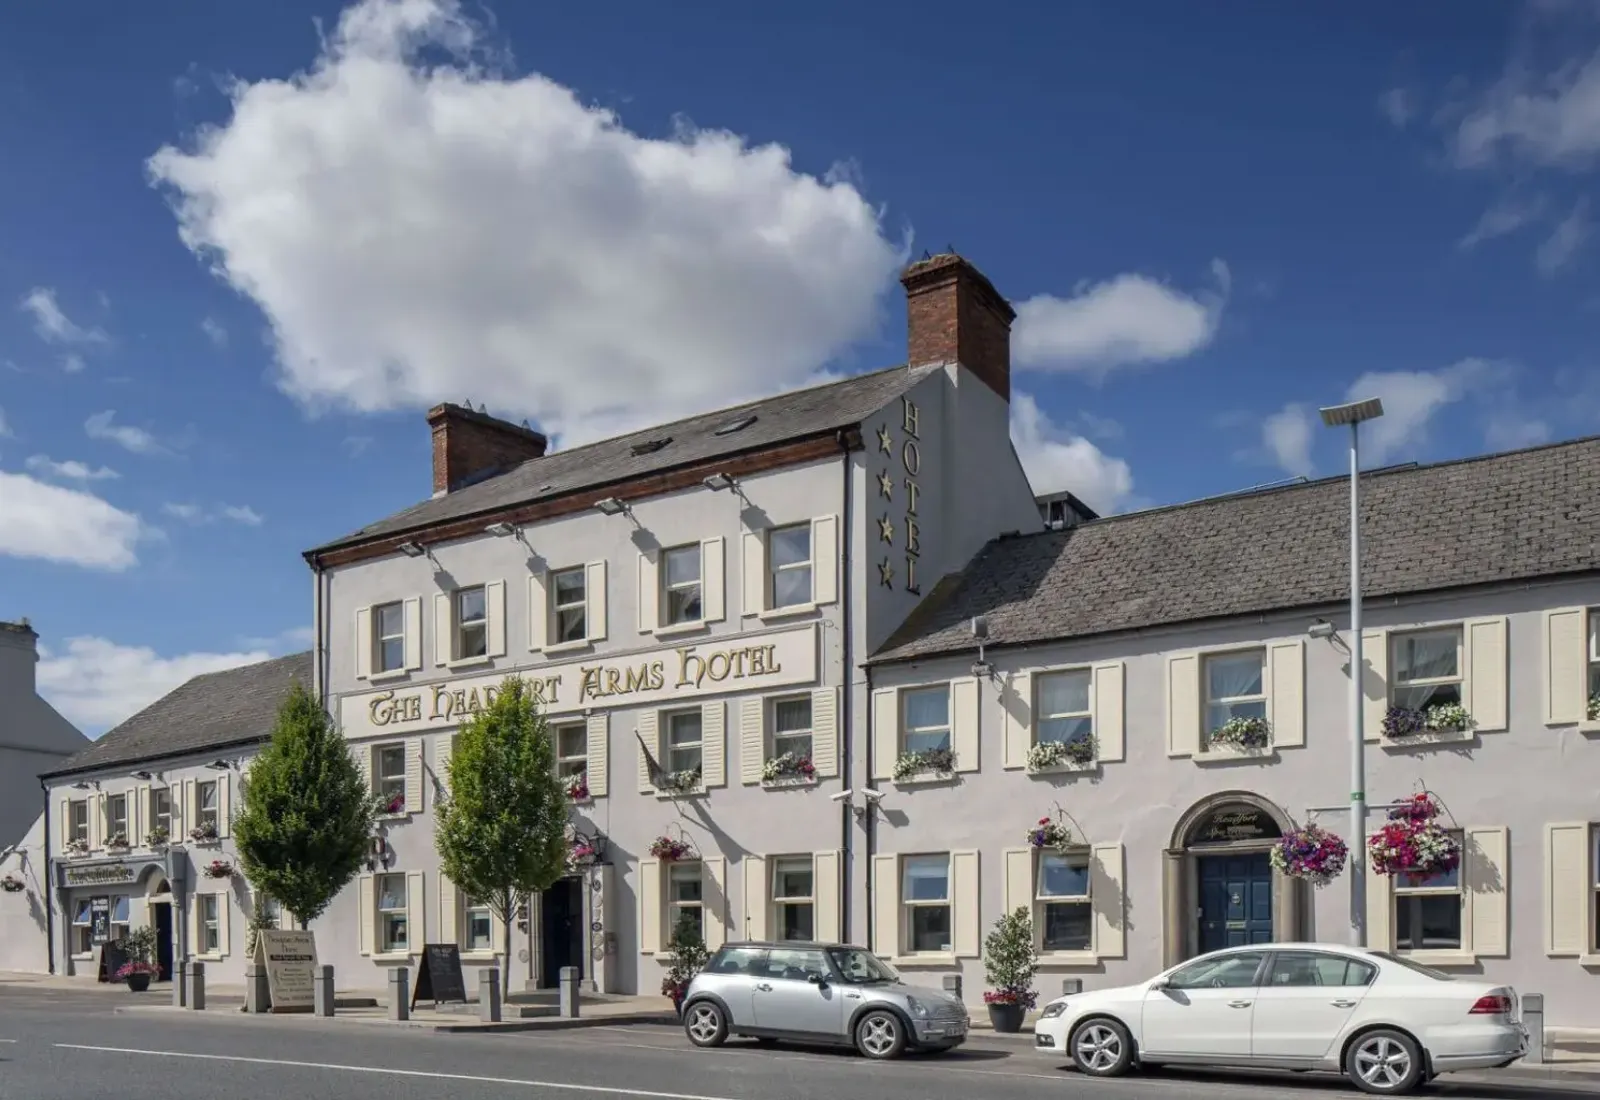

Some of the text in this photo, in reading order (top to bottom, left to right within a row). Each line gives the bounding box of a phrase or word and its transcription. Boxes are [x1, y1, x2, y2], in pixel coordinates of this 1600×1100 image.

[901, 395, 921, 597] HOTEL
[368, 644, 781, 726] THE HEADRT ARMS HOTEL
